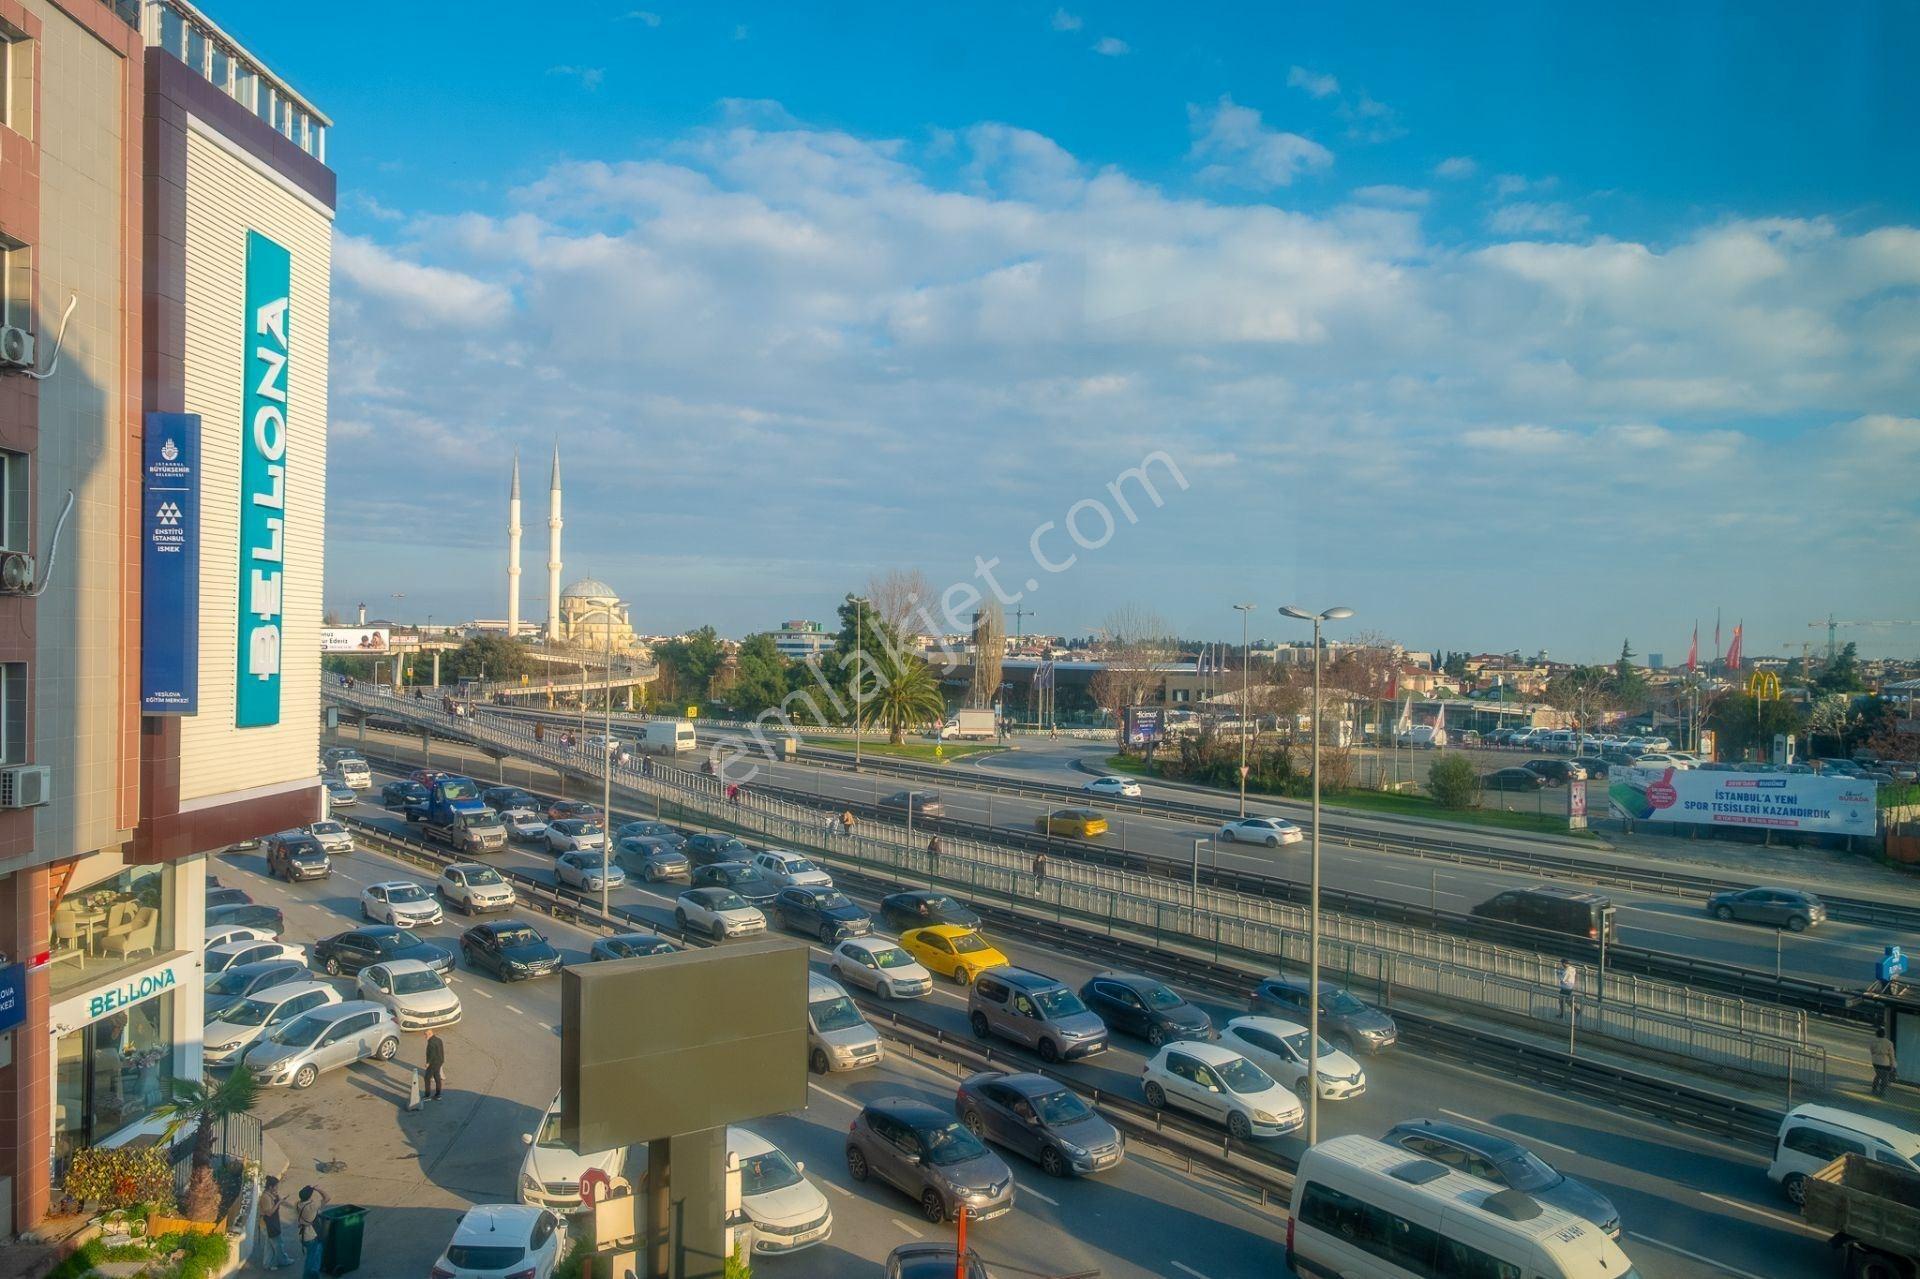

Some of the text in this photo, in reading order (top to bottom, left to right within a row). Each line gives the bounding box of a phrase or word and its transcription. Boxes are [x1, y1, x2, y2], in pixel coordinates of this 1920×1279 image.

[249, 296, 288, 681] BELLONA
[152, 534, 186, 542] İSTANBUL
[1715, 789, 1798, 805] İSTANBUL'A YENİ
[1684, 801, 1831, 819] SPOR TESİSLERİ KAZANDIRDIK
[89, 968, 176, 1019] BELLONA
[582, 1179, 609, 1201] DR
